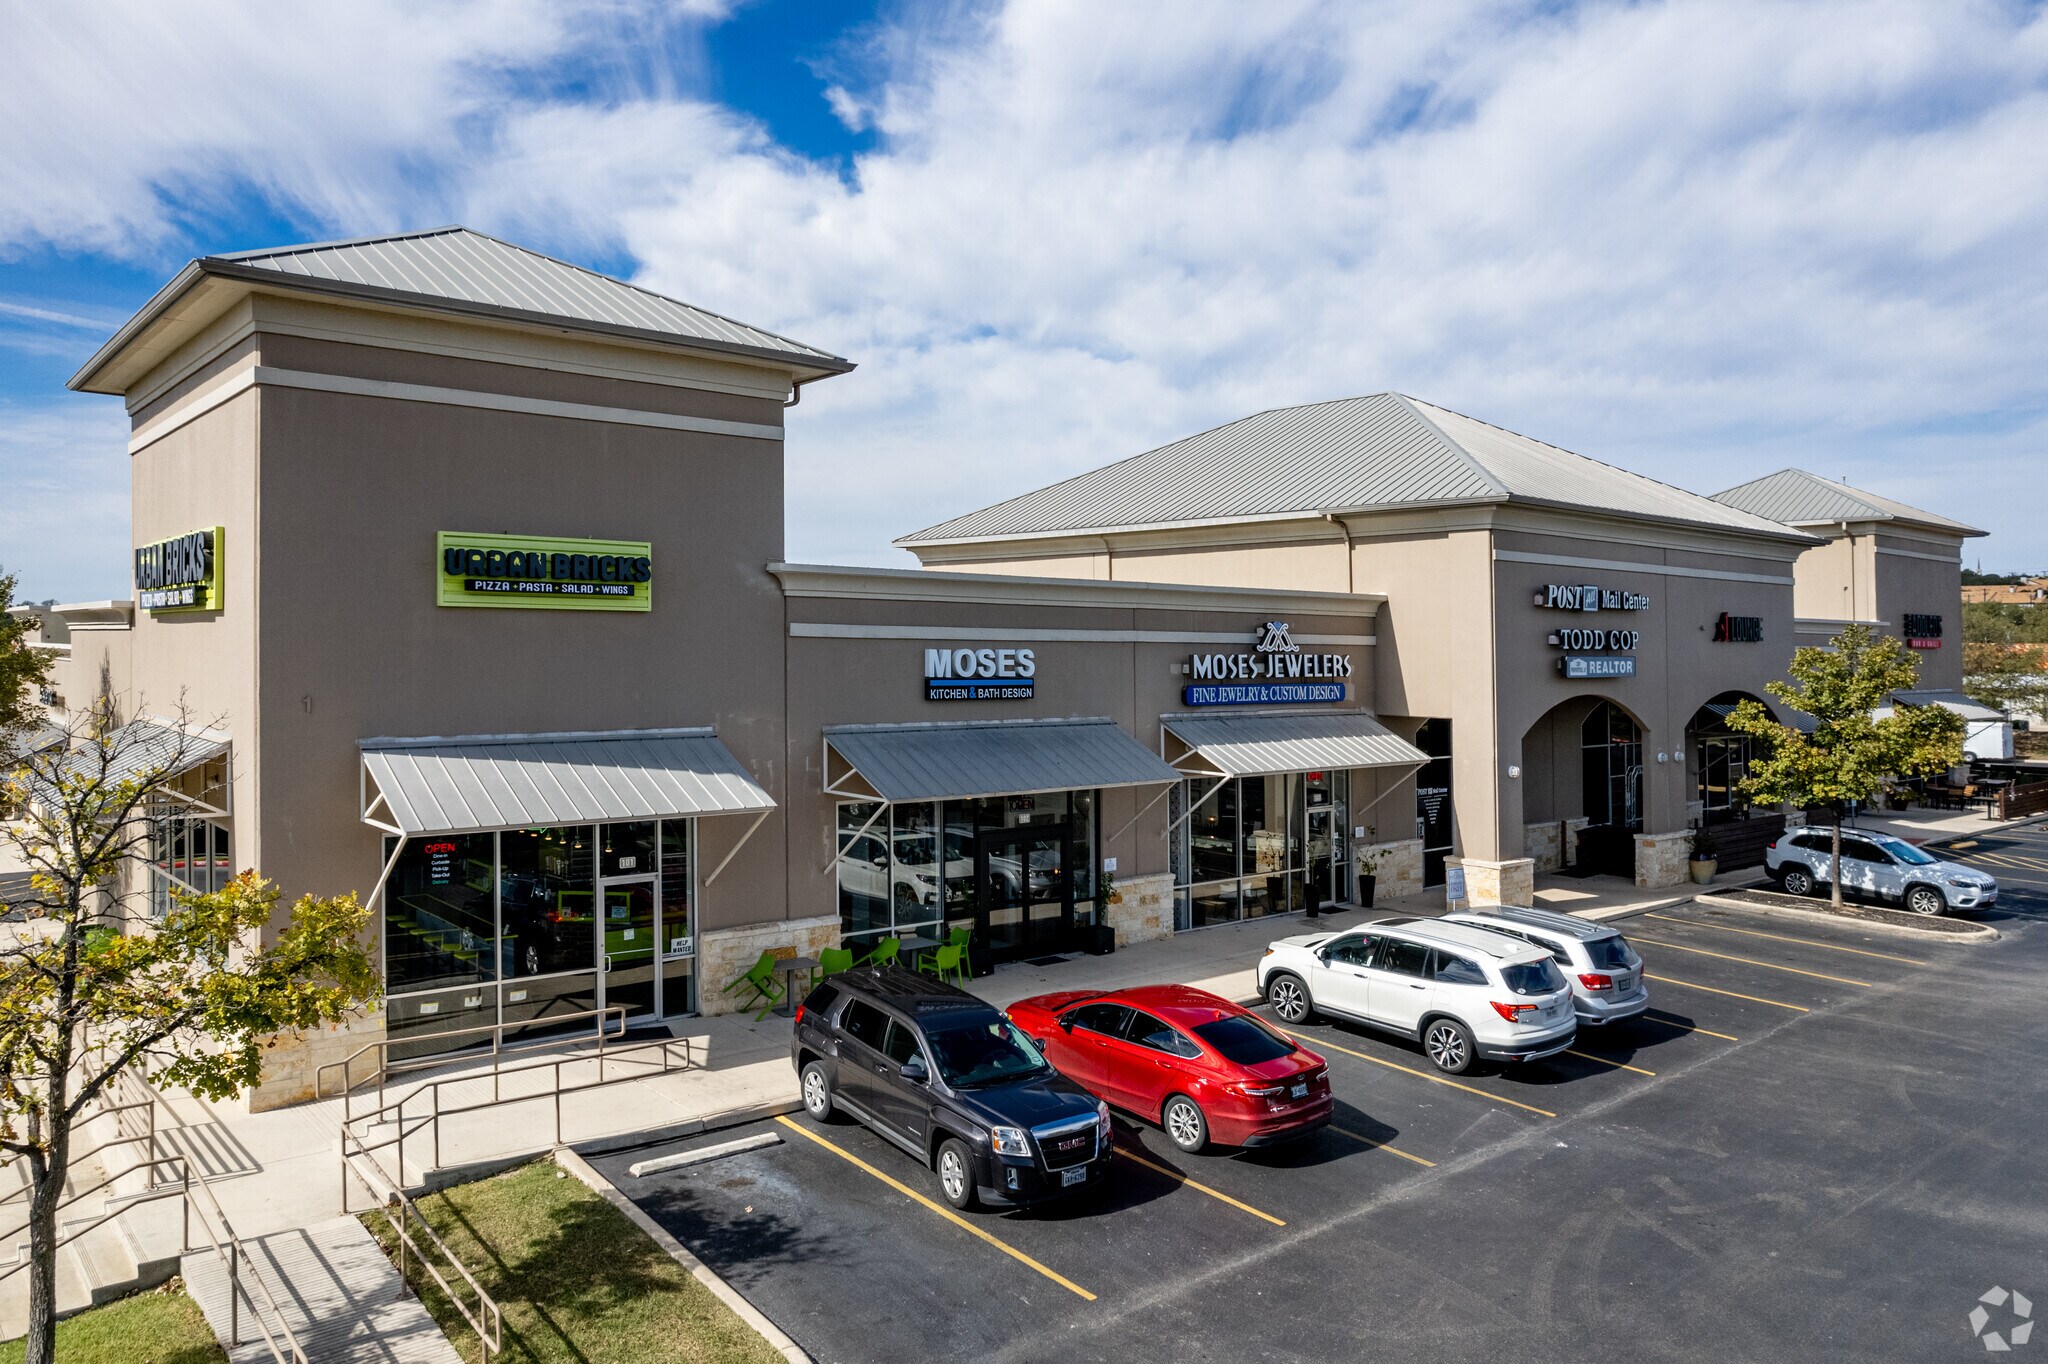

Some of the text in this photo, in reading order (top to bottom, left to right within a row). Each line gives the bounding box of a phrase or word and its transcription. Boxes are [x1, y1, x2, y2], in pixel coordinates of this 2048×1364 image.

[135, 531, 206, 589] URBAN BRICKS
[444, 548, 651, 583] URBAN BRICKS
[474, 580, 629, 595] PIZZA PASTA SALAD WINGS
[1546, 584, 1583, 609] POST
[1602, 589, 1621, 609] Mail
[1623, 590, 1650, 611] Center
[1731, 616, 1764, 642] LOUNGE
[1560, 629, 1640, 650] TODD COP
[924, 648, 1036, 678] MOSES
[1191, 653, 1352, 680] MOSES JEWELERS
[1589, 660, 1634, 674] REALTOR
[930, 686, 1033, 700] KITCHEN & BATH DESIGN
[1192, 684, 1341, 703] FINE JEWELRY & CUSTOM DESIGN
[424, 843, 456, 854] OPEN
[621, 858, 635, 867] 101
[673, 946, 692, 954] WANTED
[676, 939, 688, 947] HELP
[1058, 1136, 1086, 1151] GMC
